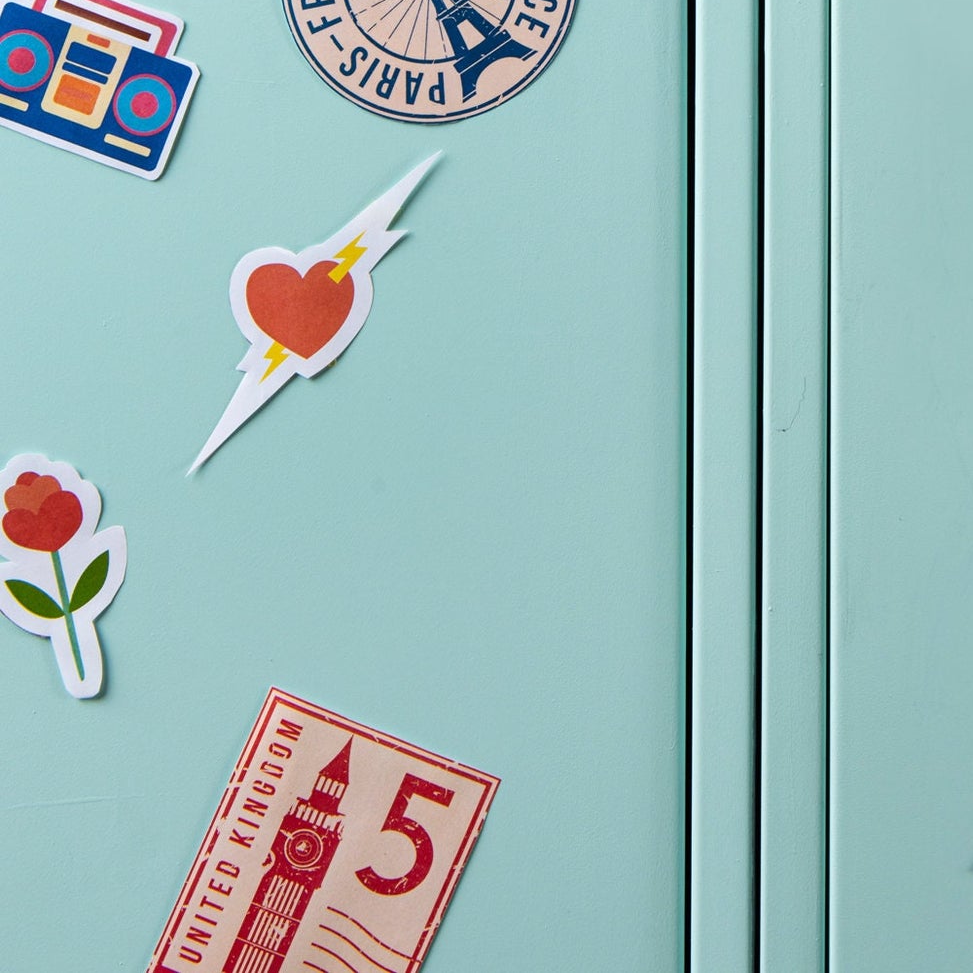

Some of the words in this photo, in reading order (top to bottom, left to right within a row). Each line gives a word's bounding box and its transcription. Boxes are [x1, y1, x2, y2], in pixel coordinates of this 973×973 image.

[178, 859, 241, 964] UNITED
[229, 718, 304, 849] KINGDOM
[354, 772, 455, 896] 5
